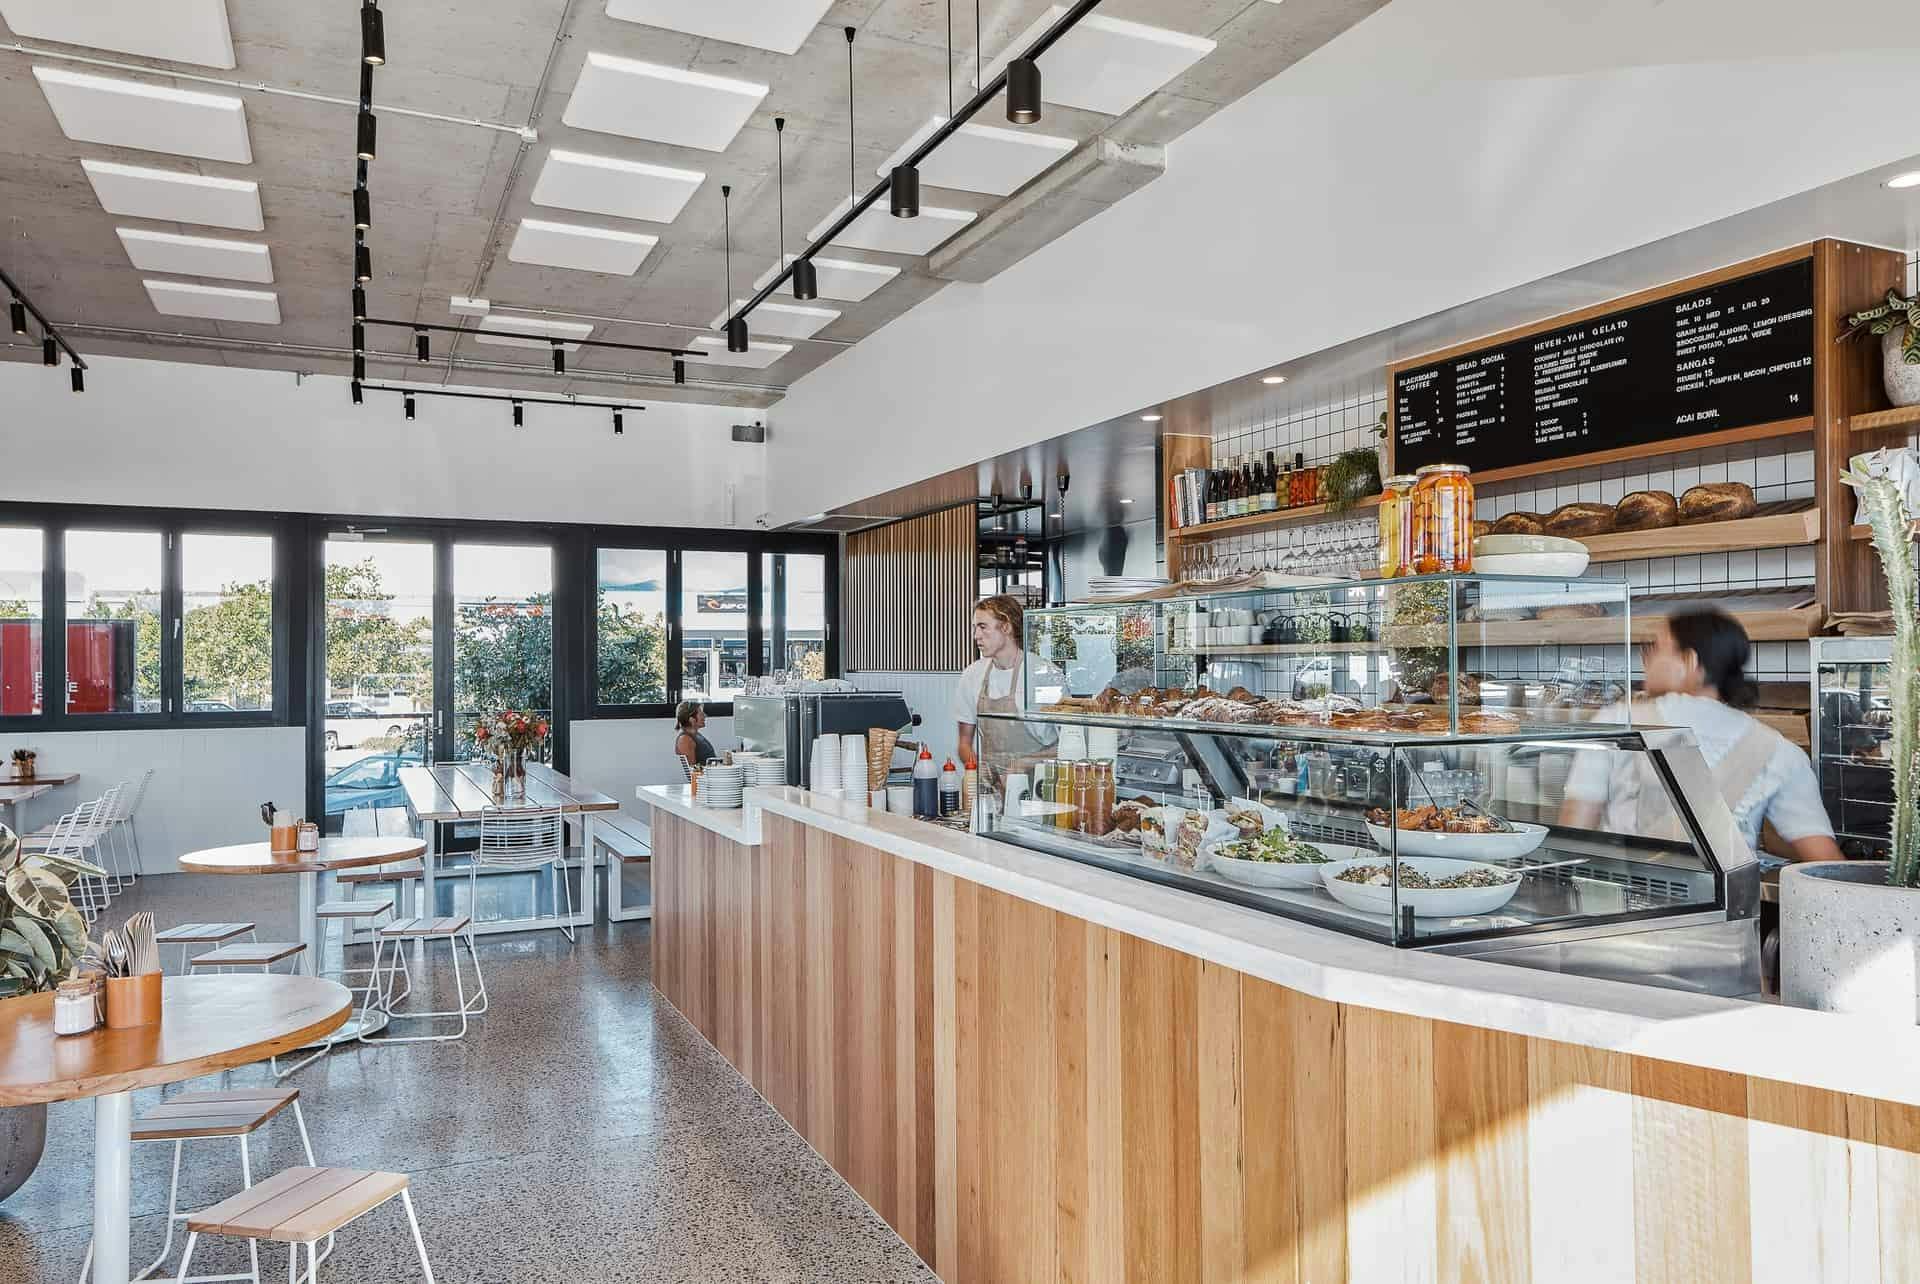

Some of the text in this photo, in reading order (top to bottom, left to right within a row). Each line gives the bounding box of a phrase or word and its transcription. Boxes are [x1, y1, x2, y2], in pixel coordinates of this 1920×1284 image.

[1675, 297, 1712, 313] SALADS
[1742, 300, 1757, 310] LRG
[1753, 317, 1777, 329] LEMON
[1778, 308, 1813, 322] DRESSING
[1592, 320, 1628, 336] GELATO
[1698, 322, 1719, 333] SALAD
[1580, 337, 1614, 352] CHOCOLATE
[1456, 353, 1505, 372] BREAD SOCIAL
[1676, 356, 1715, 372] SANGAS
[1803, 357, 1812, 366] 12
[1704, 368, 1713, 377] 15
[1405, 380, 1430, 392] COFFEE
[1789, 393, 1799, 404] 14
[1676, 408, 1720, 424] ACAI BOWL
